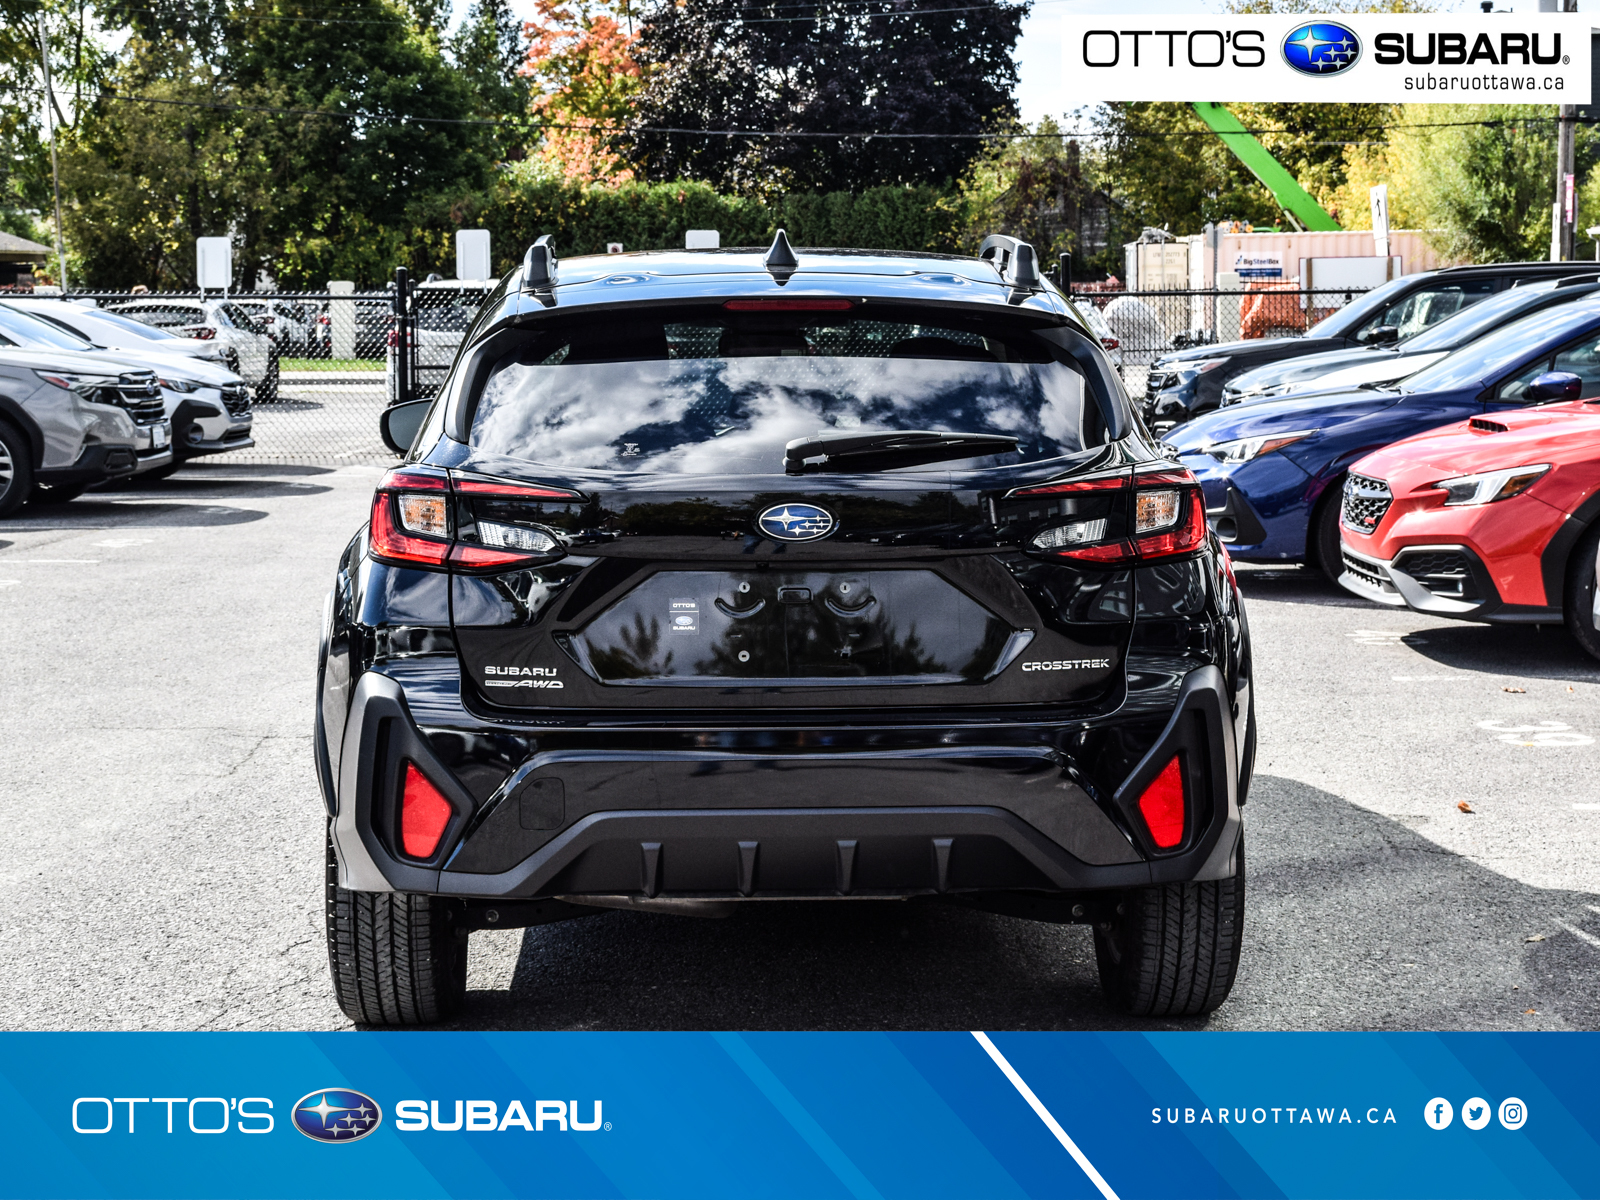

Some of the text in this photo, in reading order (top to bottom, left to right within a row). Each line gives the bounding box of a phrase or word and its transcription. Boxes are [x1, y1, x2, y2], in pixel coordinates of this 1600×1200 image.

[484, 665, 557, 677] SUBARU
[1021, 658, 1110, 672] CROSSTREK
[513, 679, 564, 689] AWD
